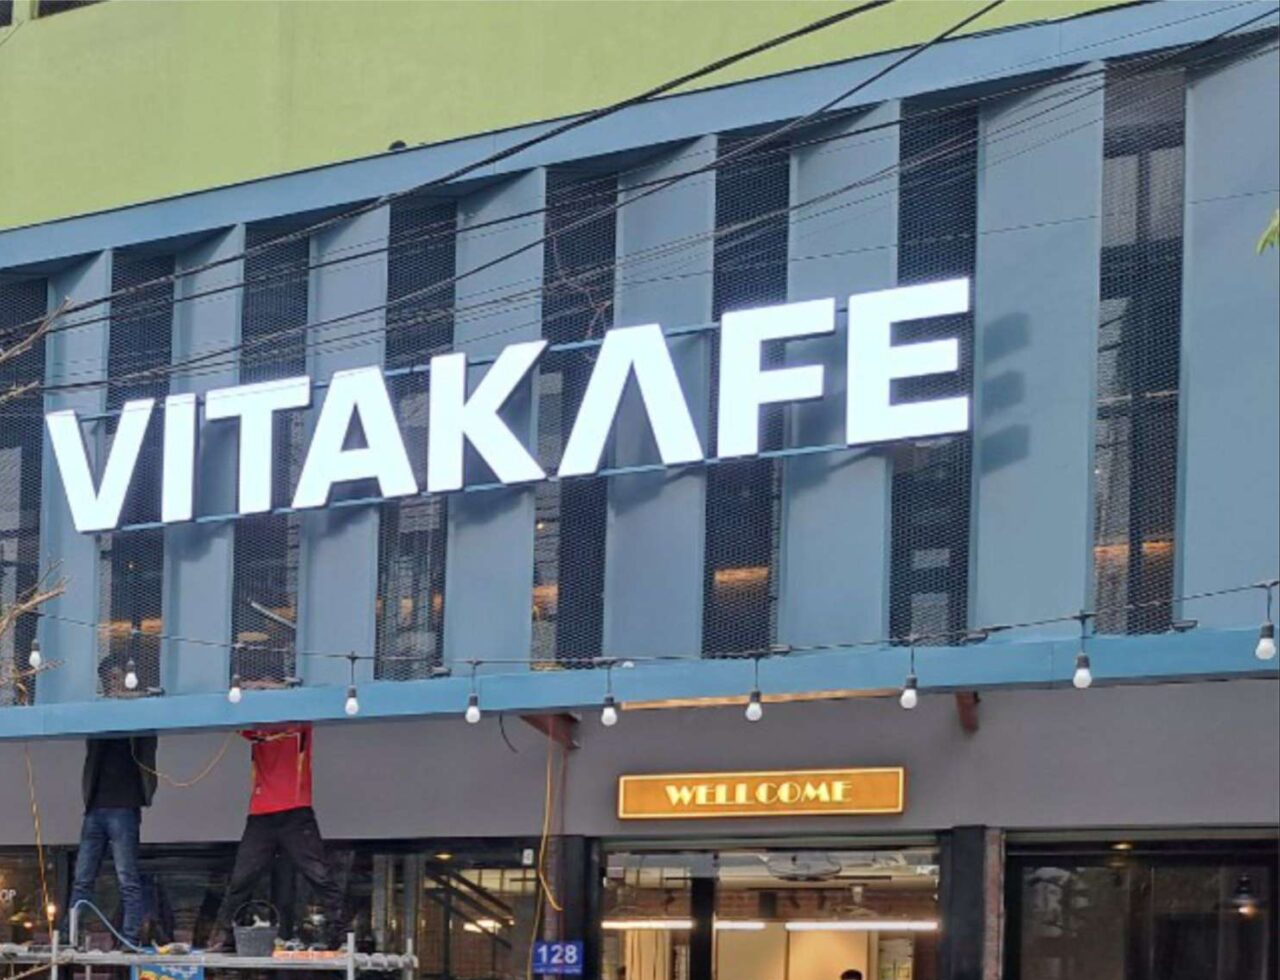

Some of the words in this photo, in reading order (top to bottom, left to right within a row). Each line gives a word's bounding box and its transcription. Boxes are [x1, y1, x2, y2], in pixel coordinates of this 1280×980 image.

[46, 277, 969, 533] VITAKAFE
[665, 781, 853, 806] WELLCOME
[537, 944, 577, 965] 128
